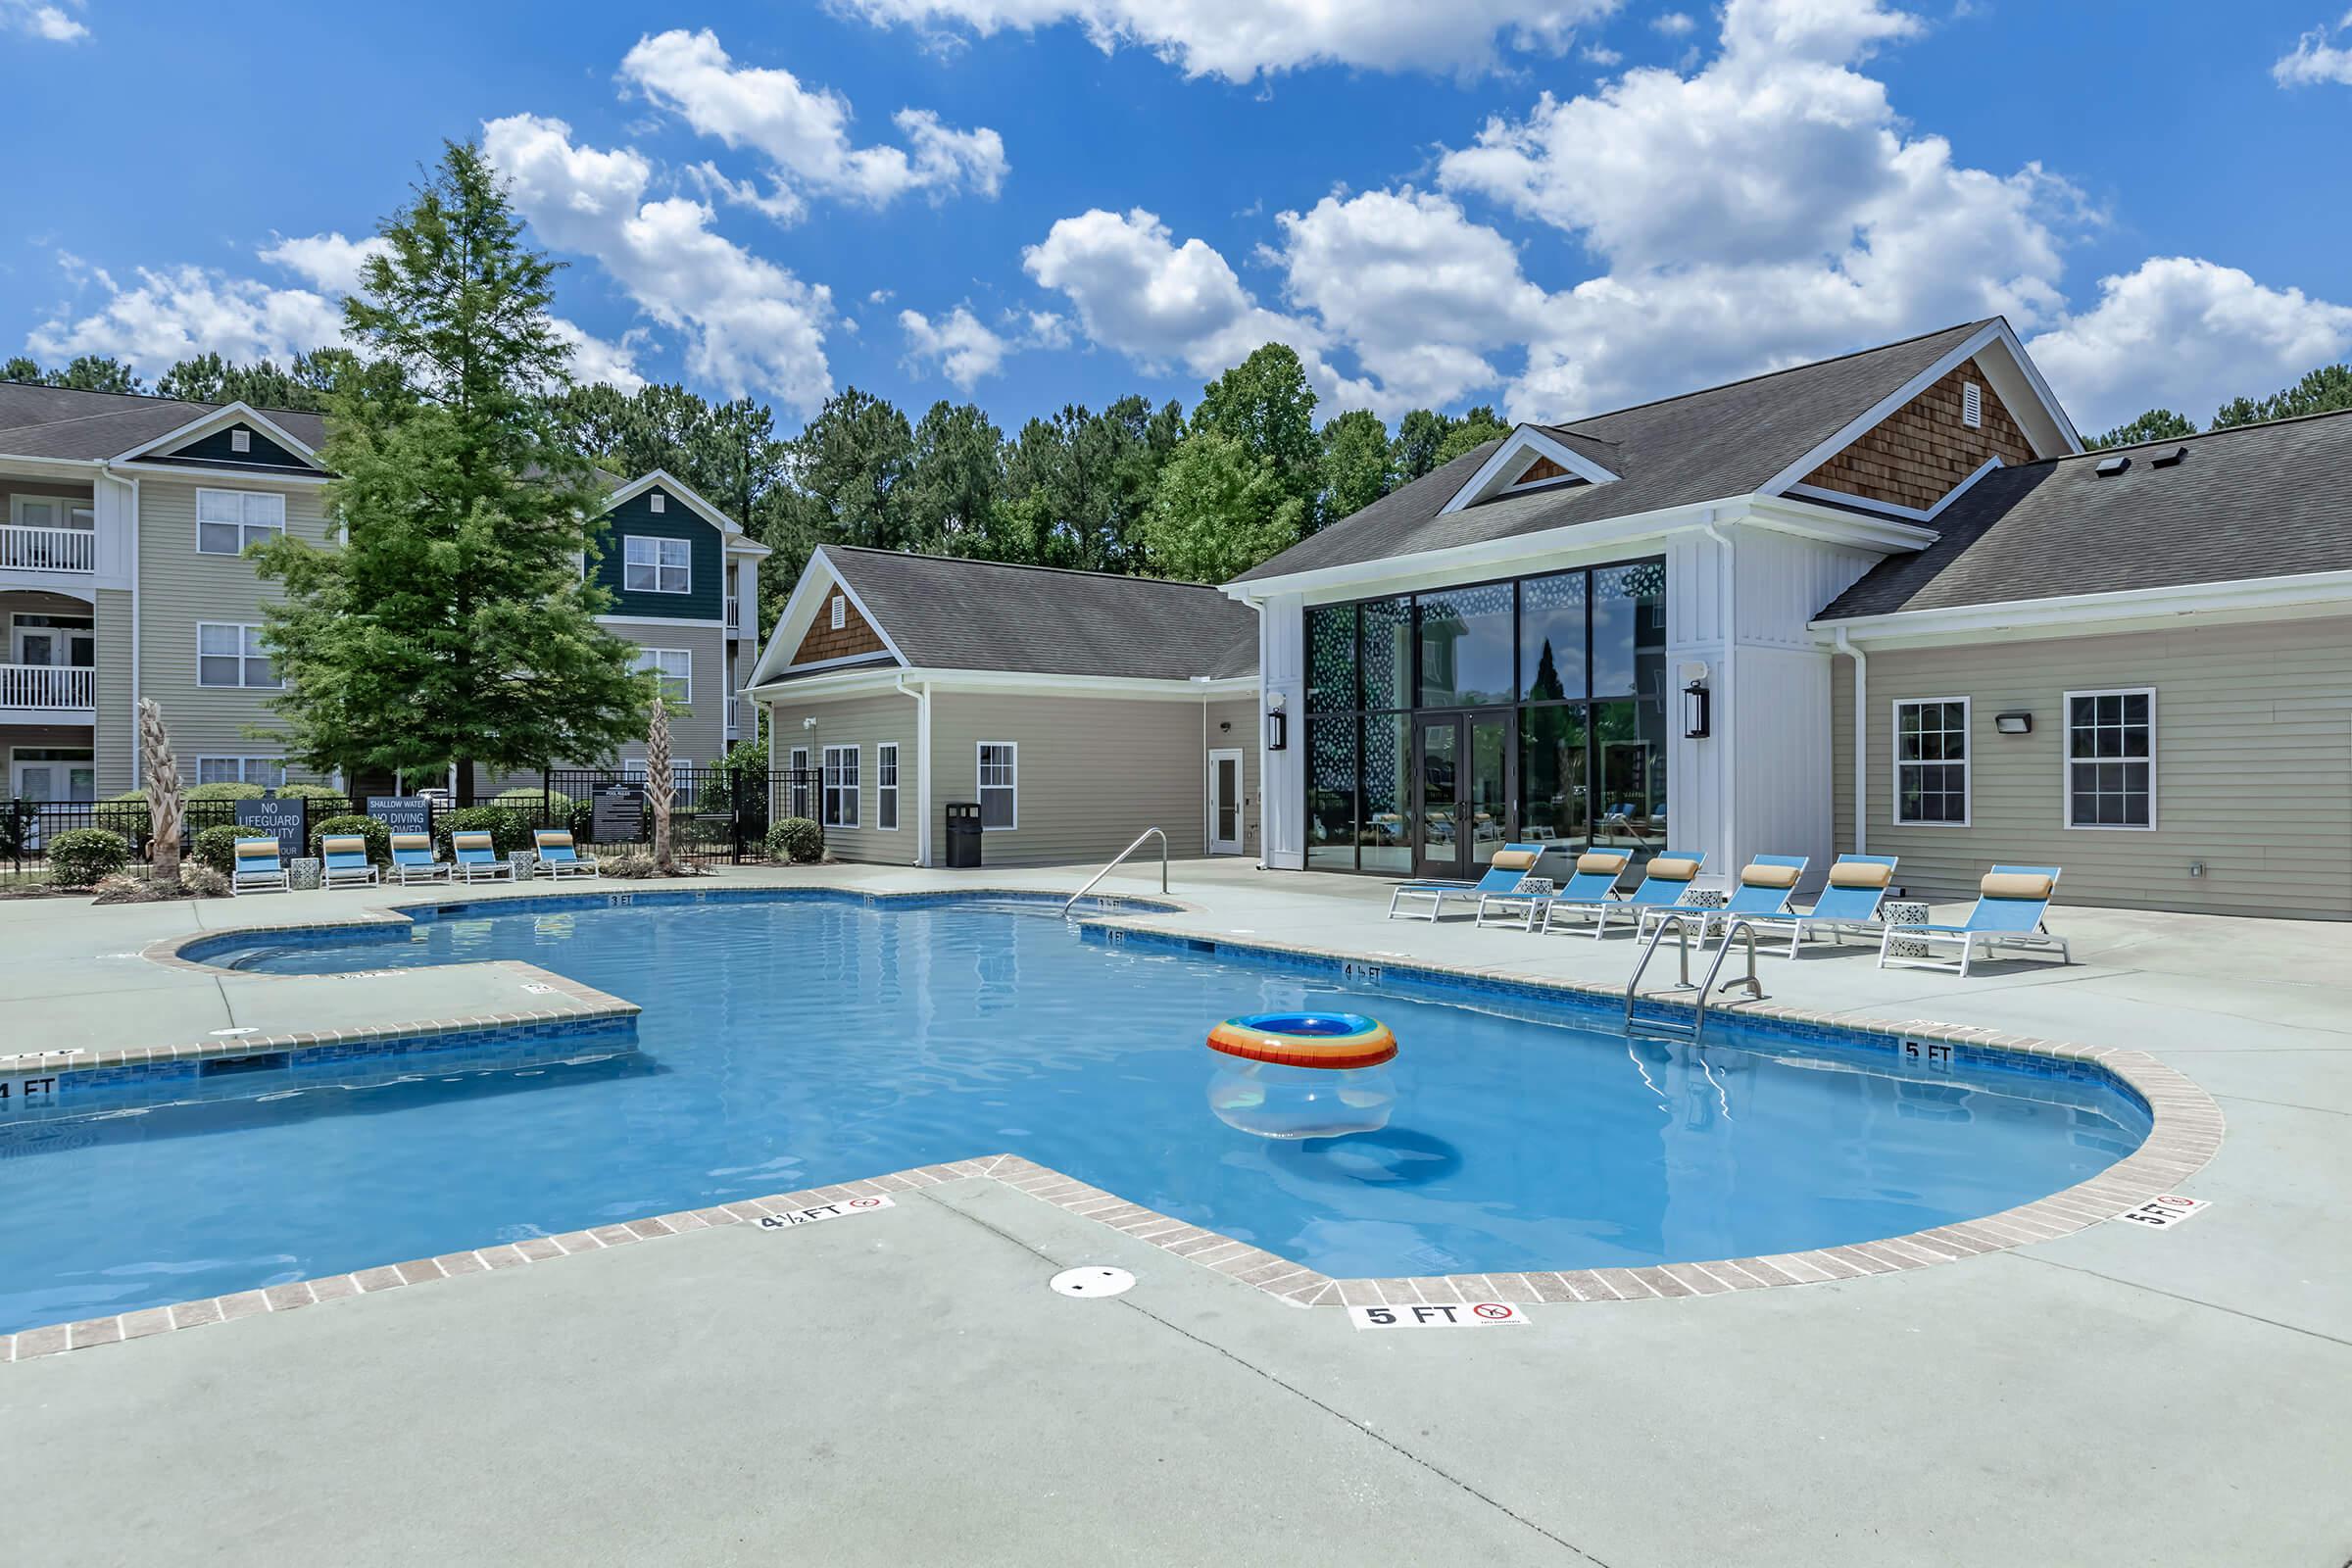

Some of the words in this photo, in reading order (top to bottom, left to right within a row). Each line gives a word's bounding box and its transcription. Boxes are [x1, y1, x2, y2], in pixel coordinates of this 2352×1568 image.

[261, 803, 278, 813] NO
[238, 814, 300, 827] LIFEGUARD
[391, 812, 424, 824] DIVING
[280, 847, 297, 856] OUR
[612, 895, 617, 906] 3
[1345, 963, 1351, 974] 4
[1369, 966, 1381, 978] FT
[1905, 1041, 1919, 1057] 5
[1928, 1044, 1952, 1061] FT
[24, 1077, 56, 1097] FT
[803, 1204, 842, 1219] FT
[2139, 1202, 2186, 1219] FT
[2124, 1213, 2167, 1225] 5
[1366, 1308, 1397, 1324] 5
[1411, 1306, 1458, 1324] FT
